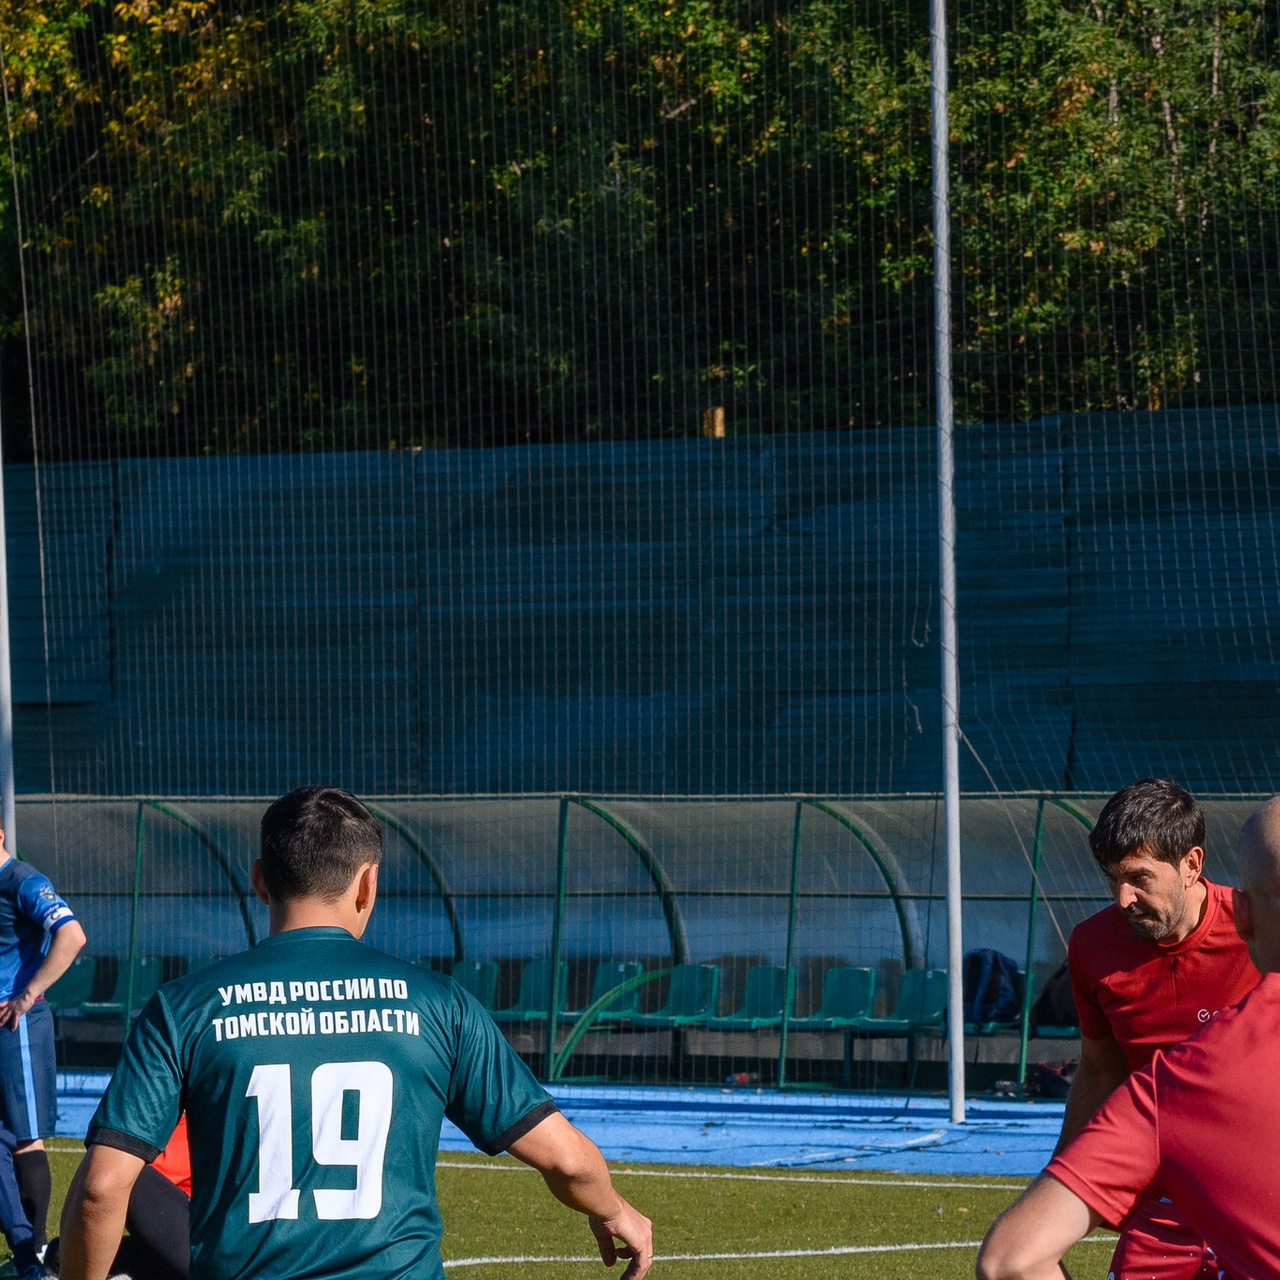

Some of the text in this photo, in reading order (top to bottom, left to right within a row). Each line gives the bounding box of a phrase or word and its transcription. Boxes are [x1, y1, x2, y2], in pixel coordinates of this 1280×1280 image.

[218, 978, 408, 1006] УМВД РОССИИ ПО
[212, 1008, 420, 1042] ТОМСКОЙ ОБЛАСТИ
[245, 1061, 393, 1223] 19
